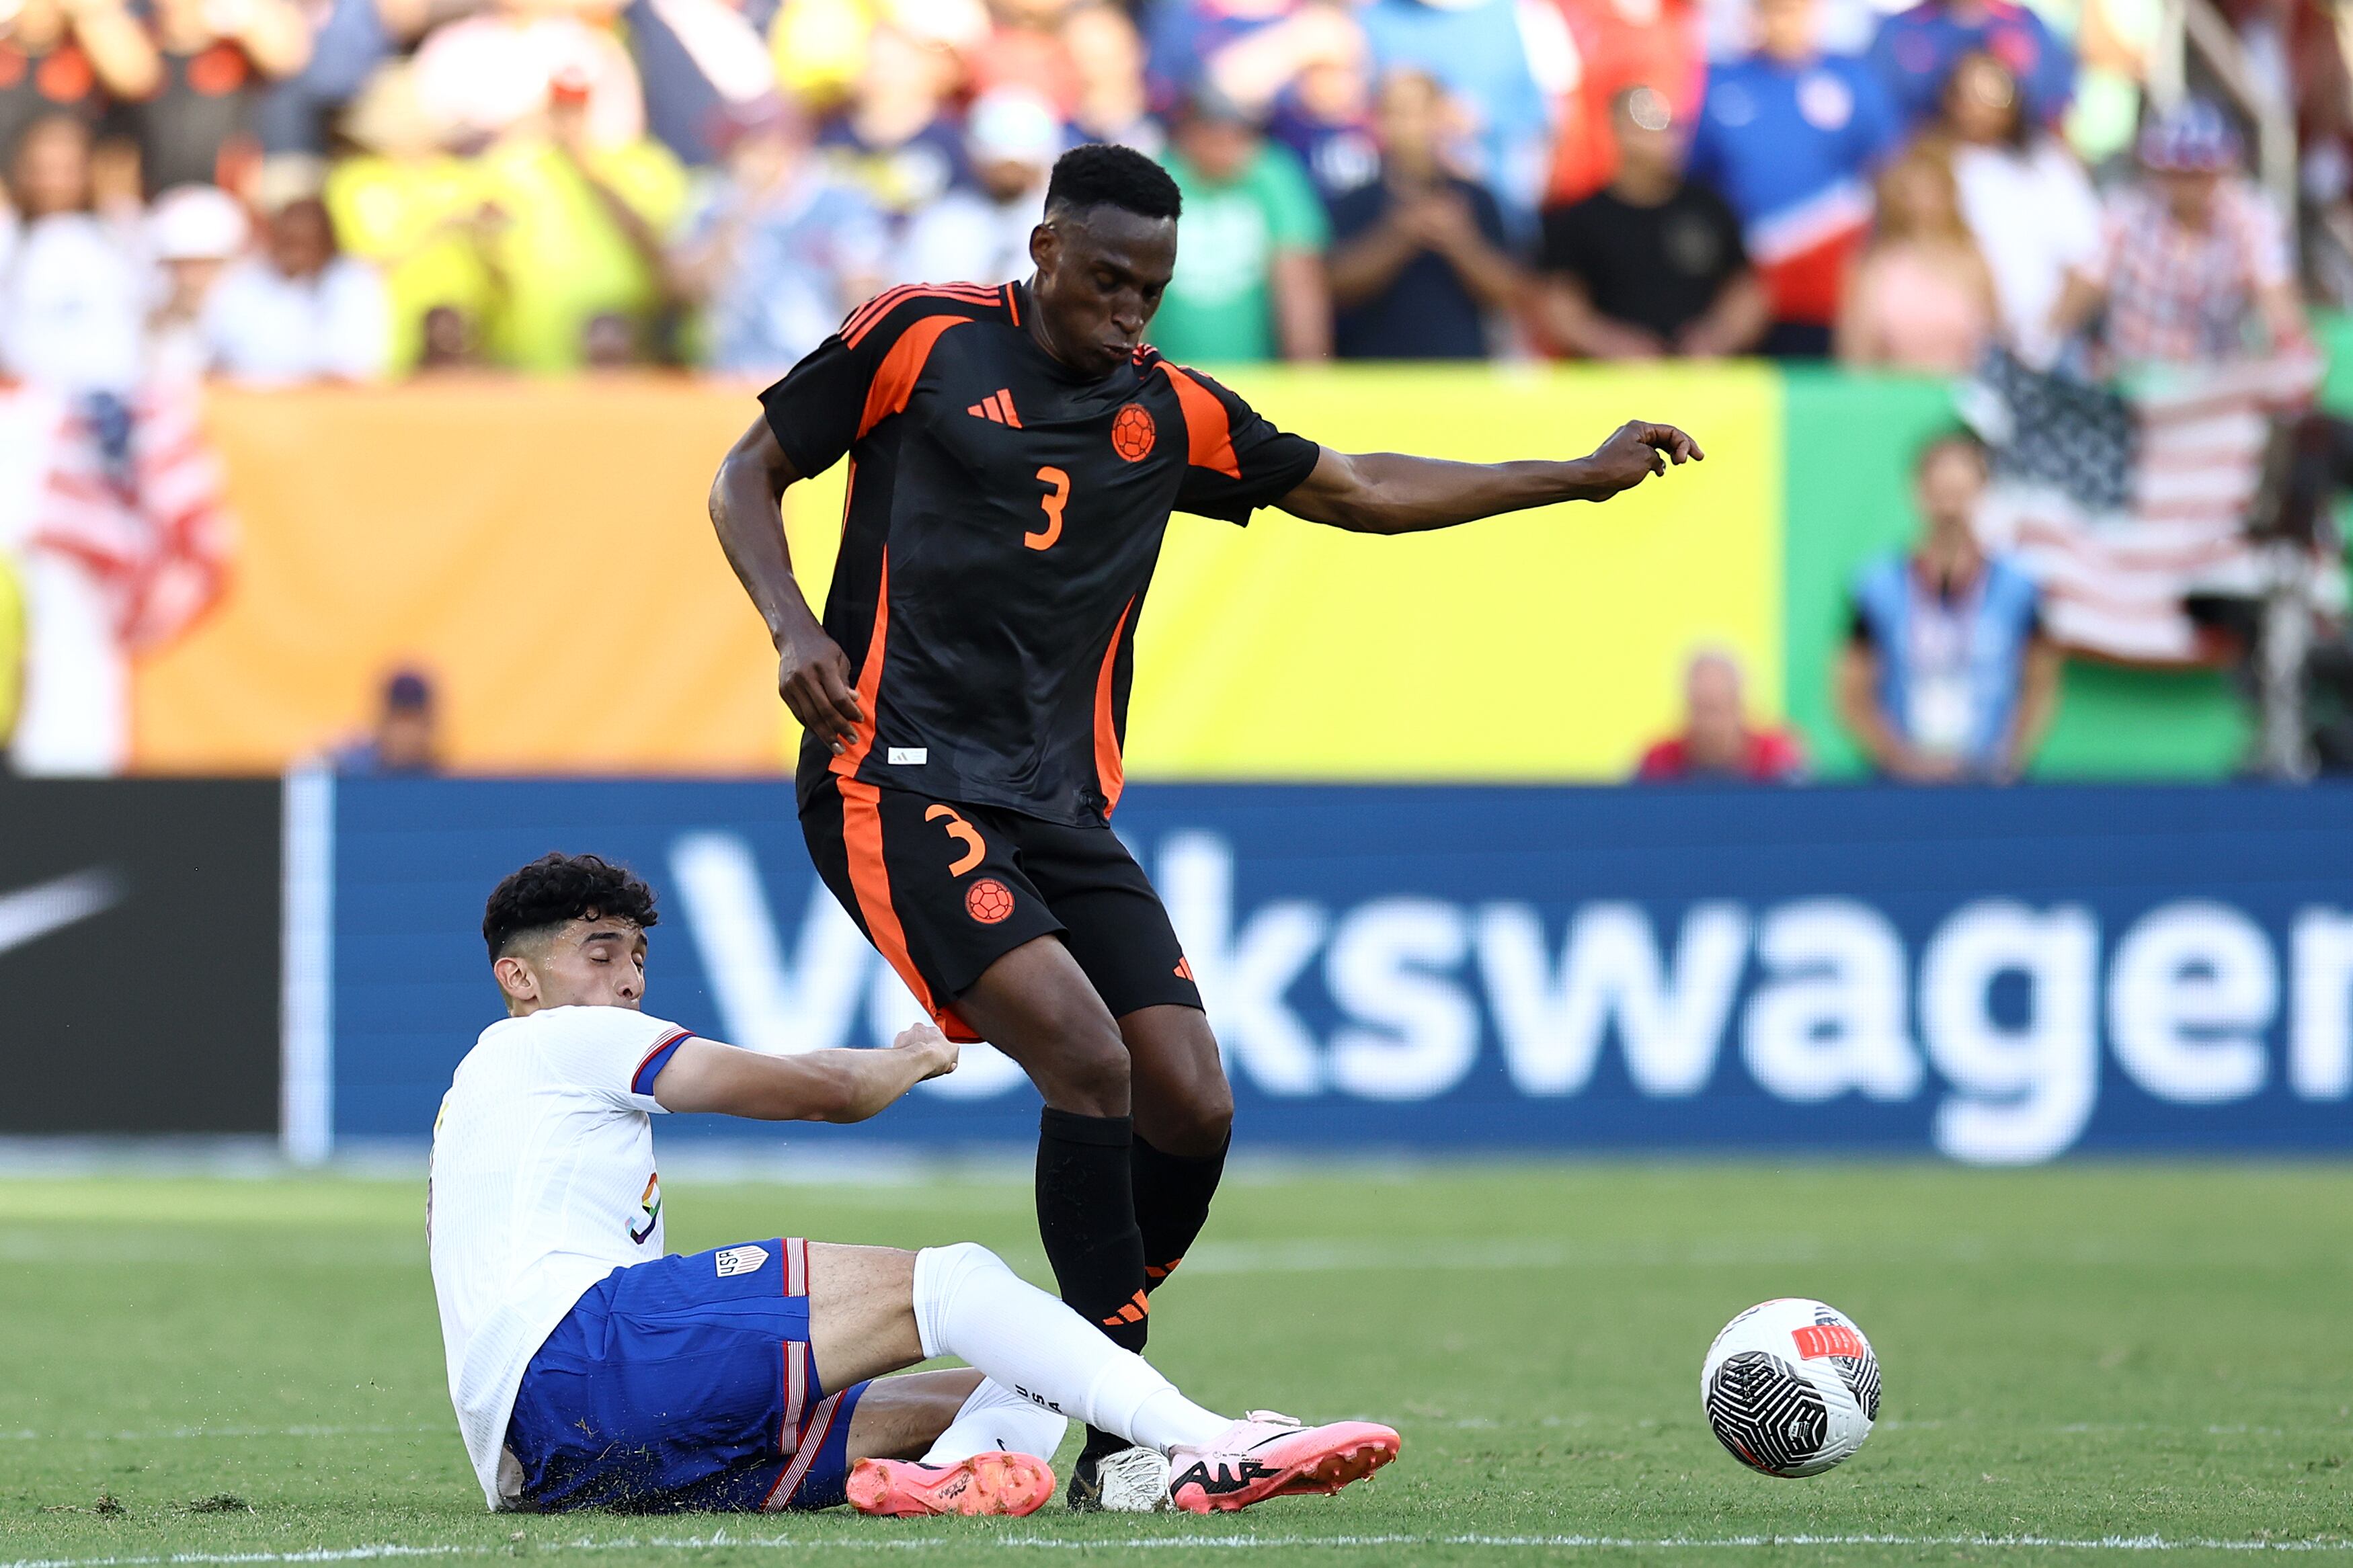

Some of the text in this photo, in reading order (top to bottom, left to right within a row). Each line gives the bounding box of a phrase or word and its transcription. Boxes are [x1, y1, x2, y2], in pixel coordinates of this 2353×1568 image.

[1024, 466, 1070, 551] 3
[924, 804, 986, 878] 3
[670, 832, 2353, 1165] Vkswage
[719, 1251, 739, 1275] USA
[1014, 1384, 1063, 1413] USA
